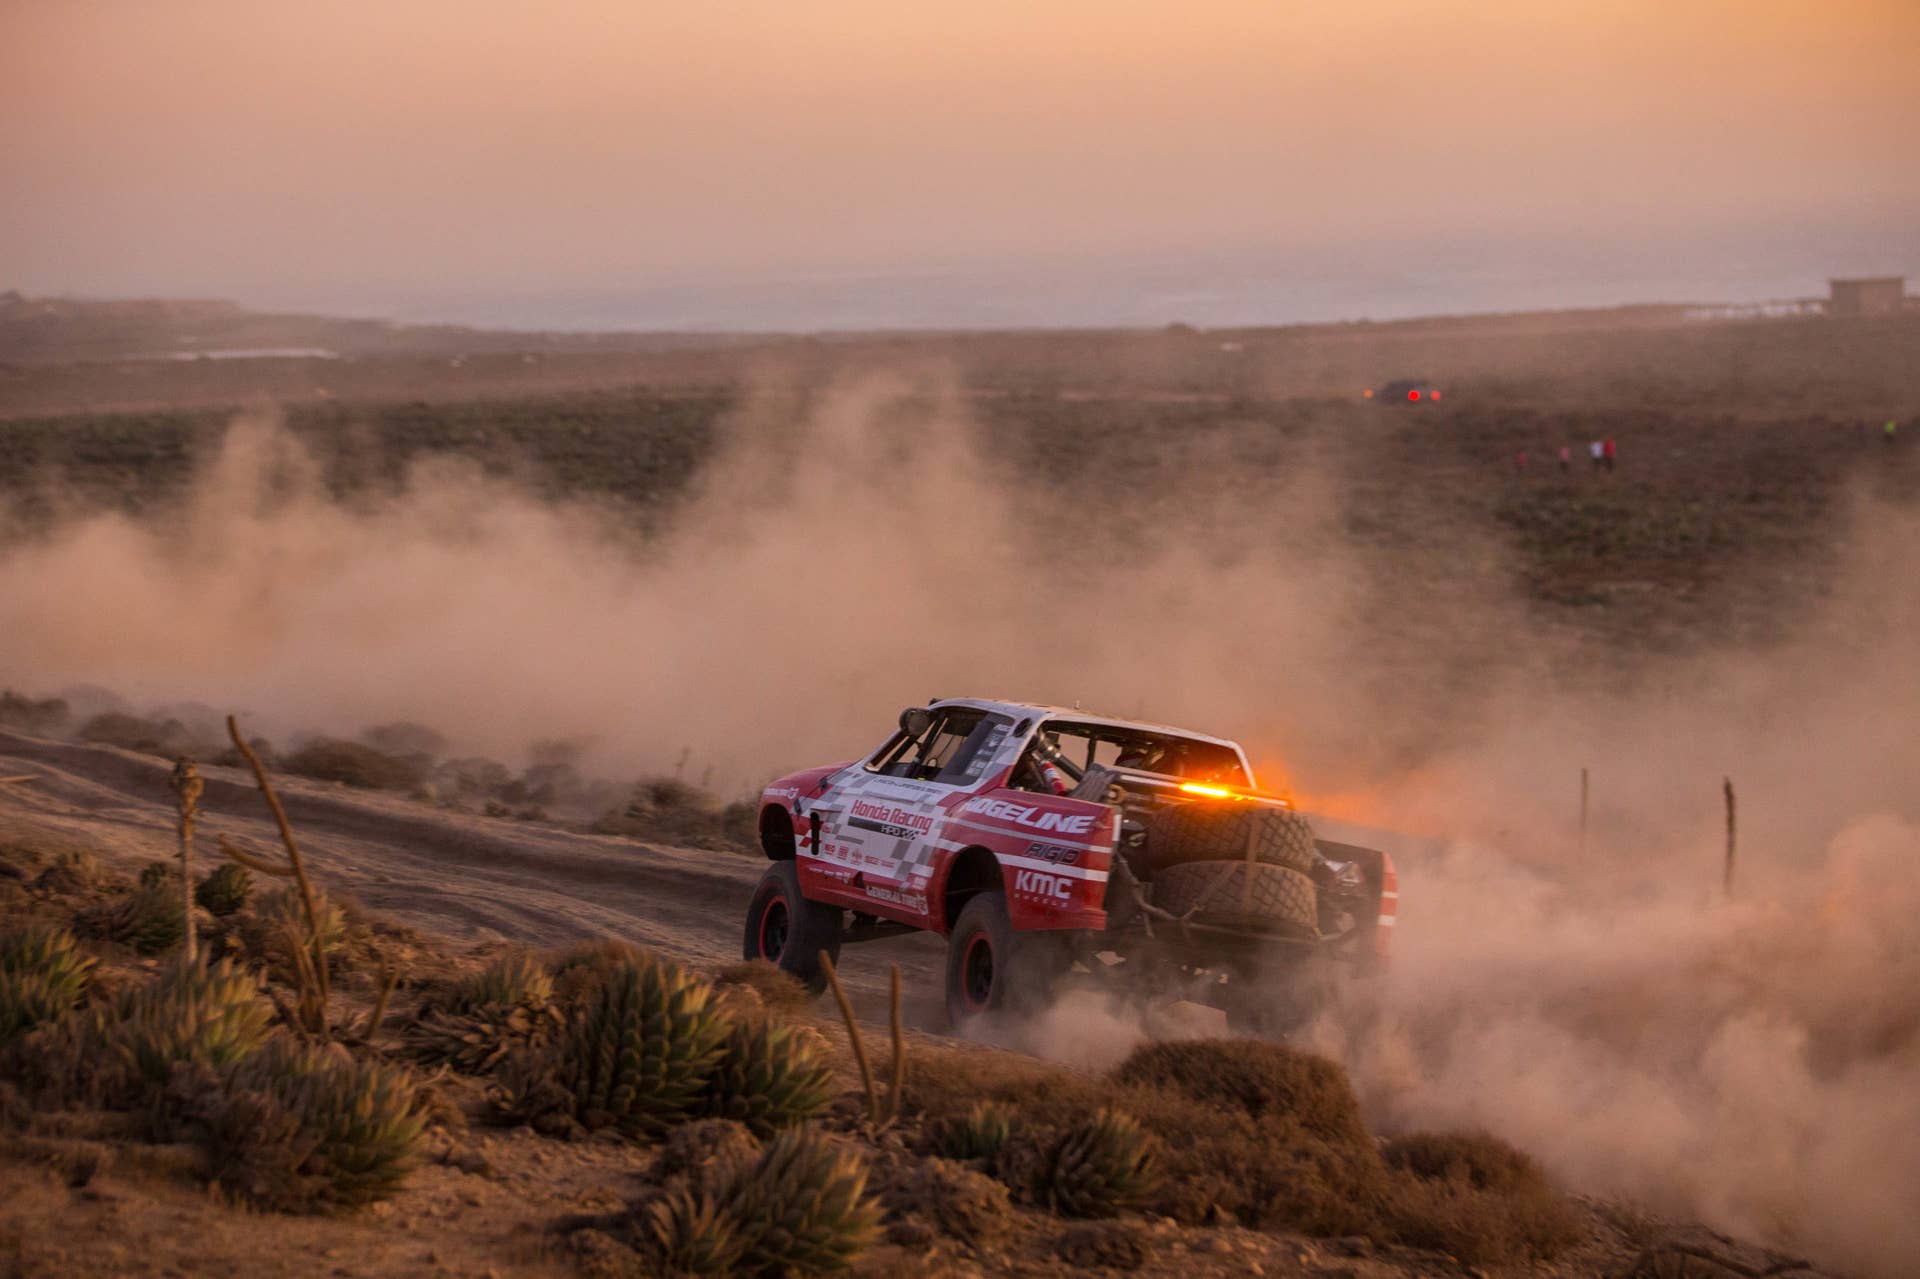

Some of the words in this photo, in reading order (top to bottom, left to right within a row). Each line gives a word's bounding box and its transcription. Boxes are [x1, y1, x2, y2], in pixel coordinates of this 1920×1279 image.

[851, 799, 890, 821] Honda
[890, 808, 934, 836] Racing
[1024, 843, 1080, 865] RIGID
[1015, 869, 1073, 899] KMC
